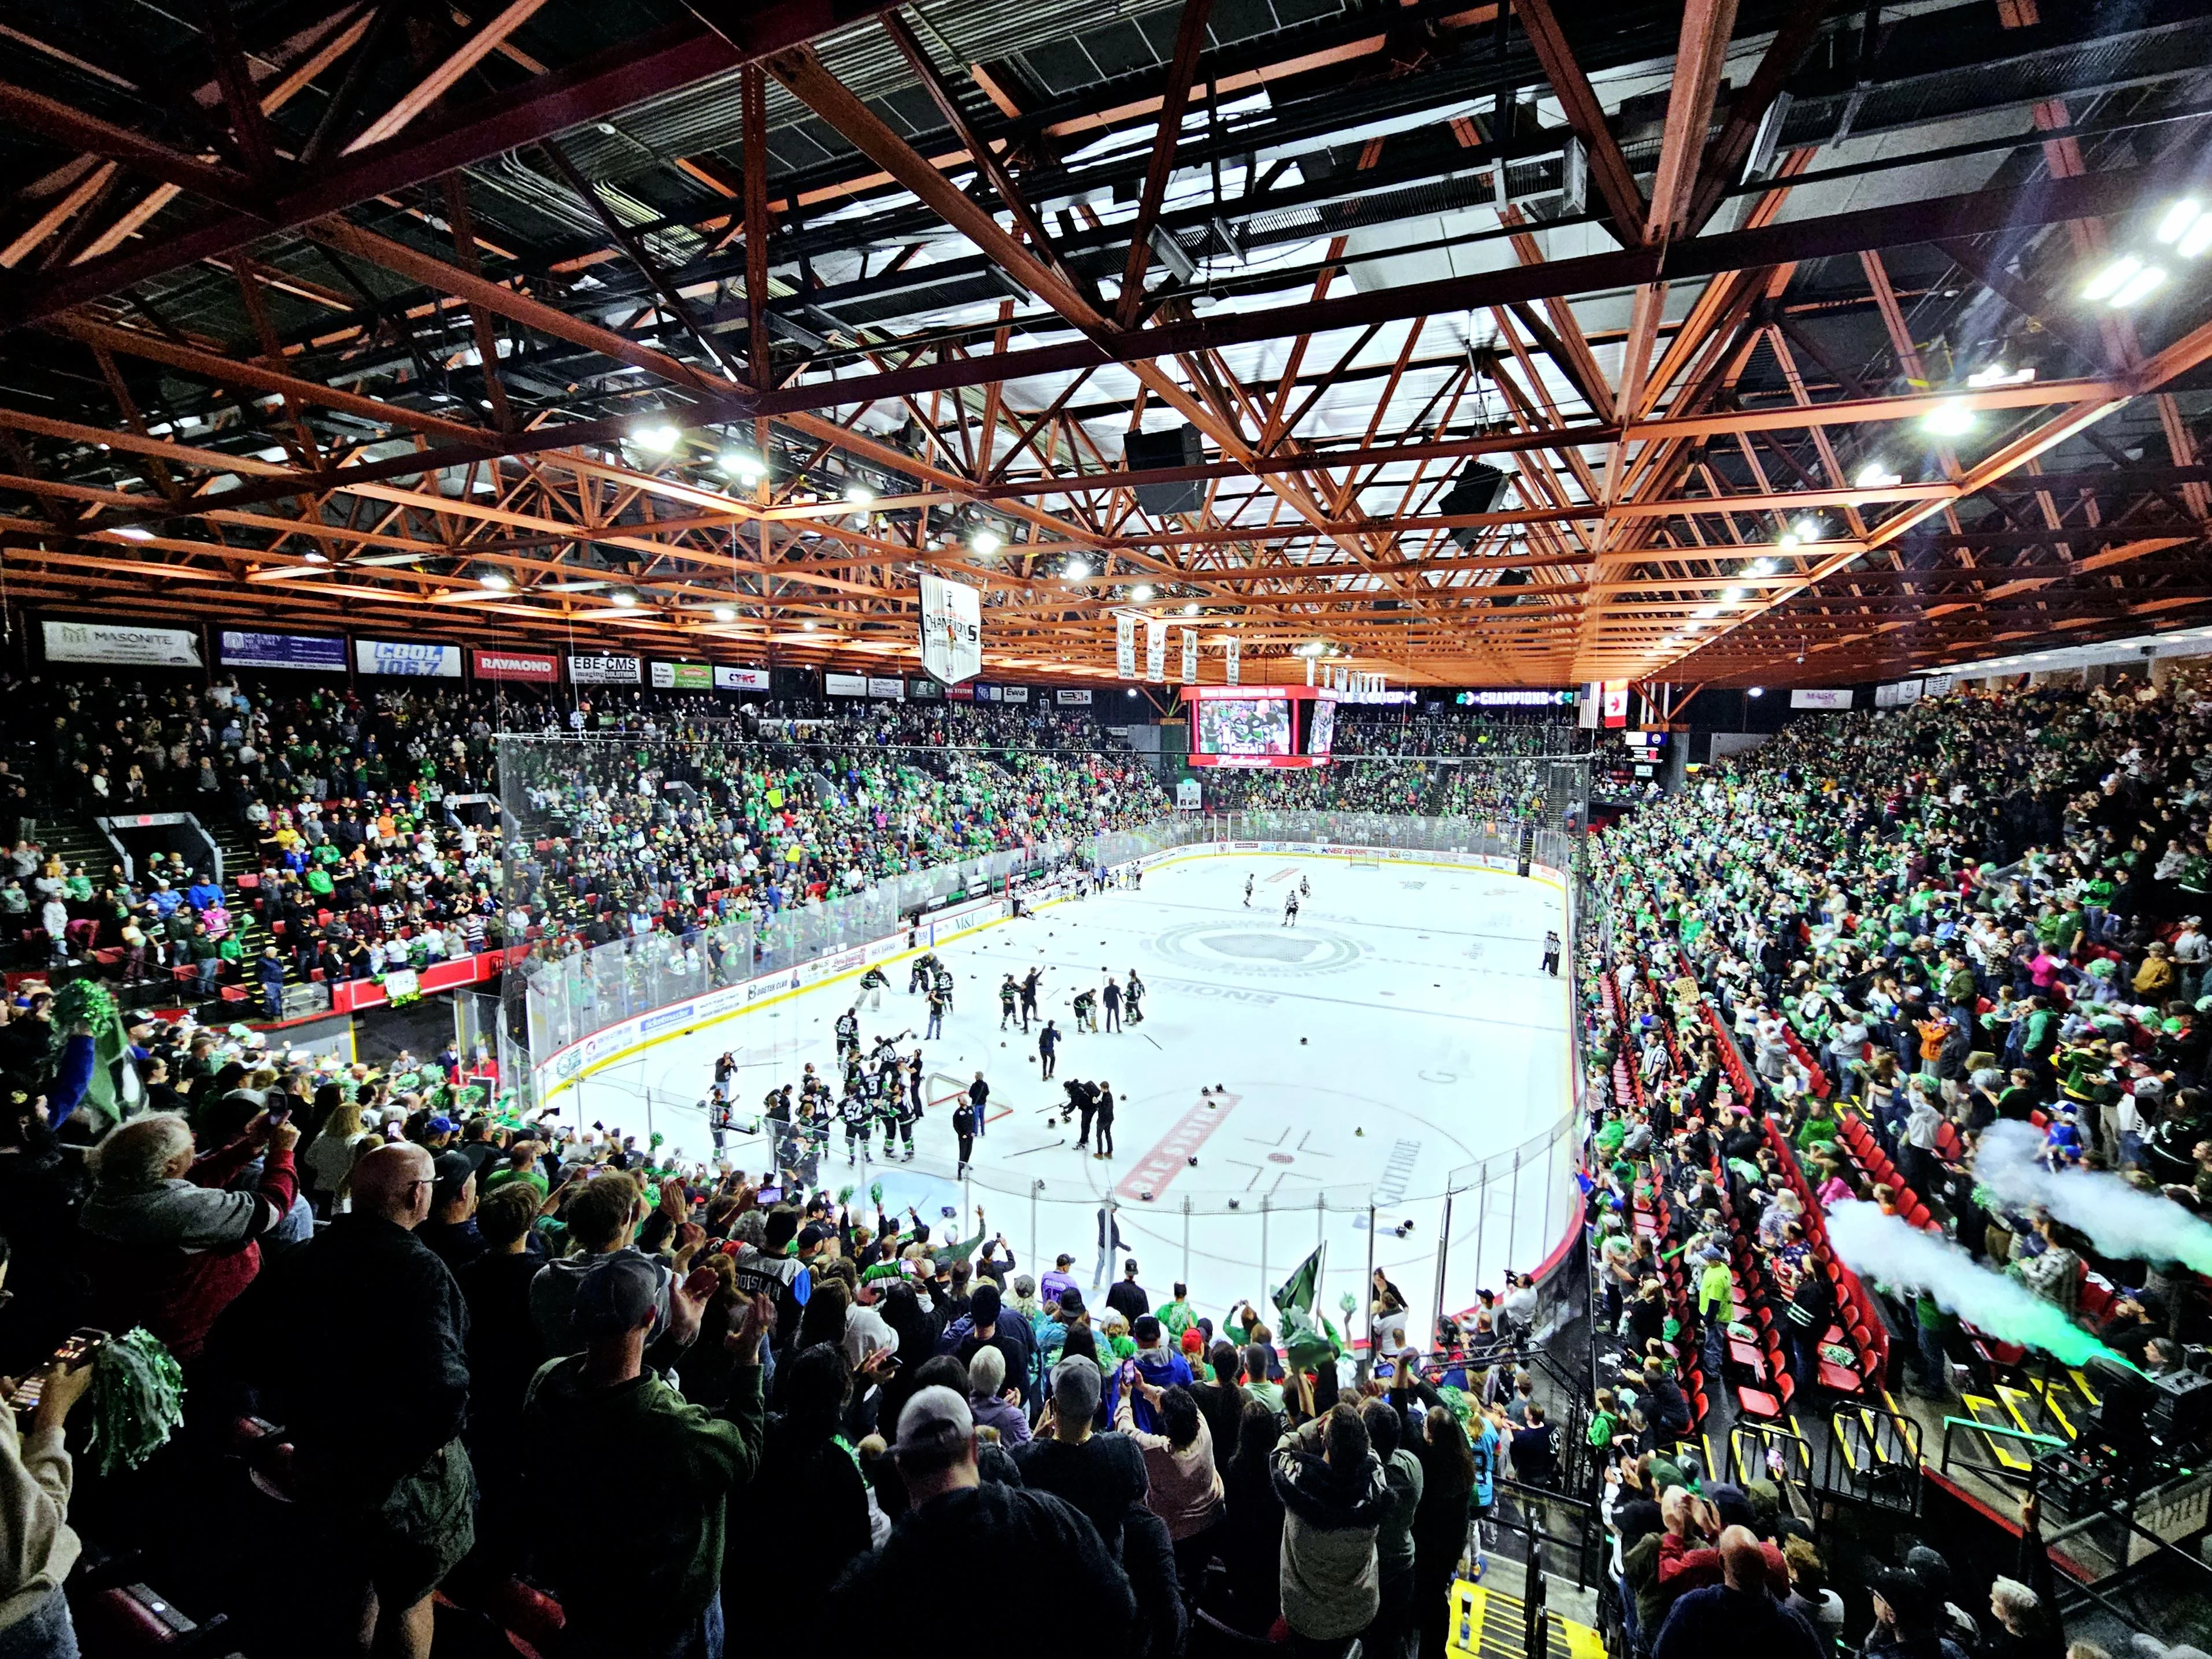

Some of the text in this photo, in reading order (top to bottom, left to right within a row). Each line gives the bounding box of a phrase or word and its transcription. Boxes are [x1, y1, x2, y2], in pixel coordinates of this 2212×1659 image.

[94, 631, 173, 645] MASONITE
[376, 642, 443, 661] COOL
[376, 661, 438, 675] 106.7
[481, 657, 552, 672] RAYMOND
[574, 657, 635, 669] EBE-CMS
[1480, 692, 1549, 705] CHAMPIONS
[939, 978, 951, 989] 92
[838, 1021, 852, 1034] 61
[868, 1080, 878, 1095] 9
[844, 1097, 863, 1121] 52
